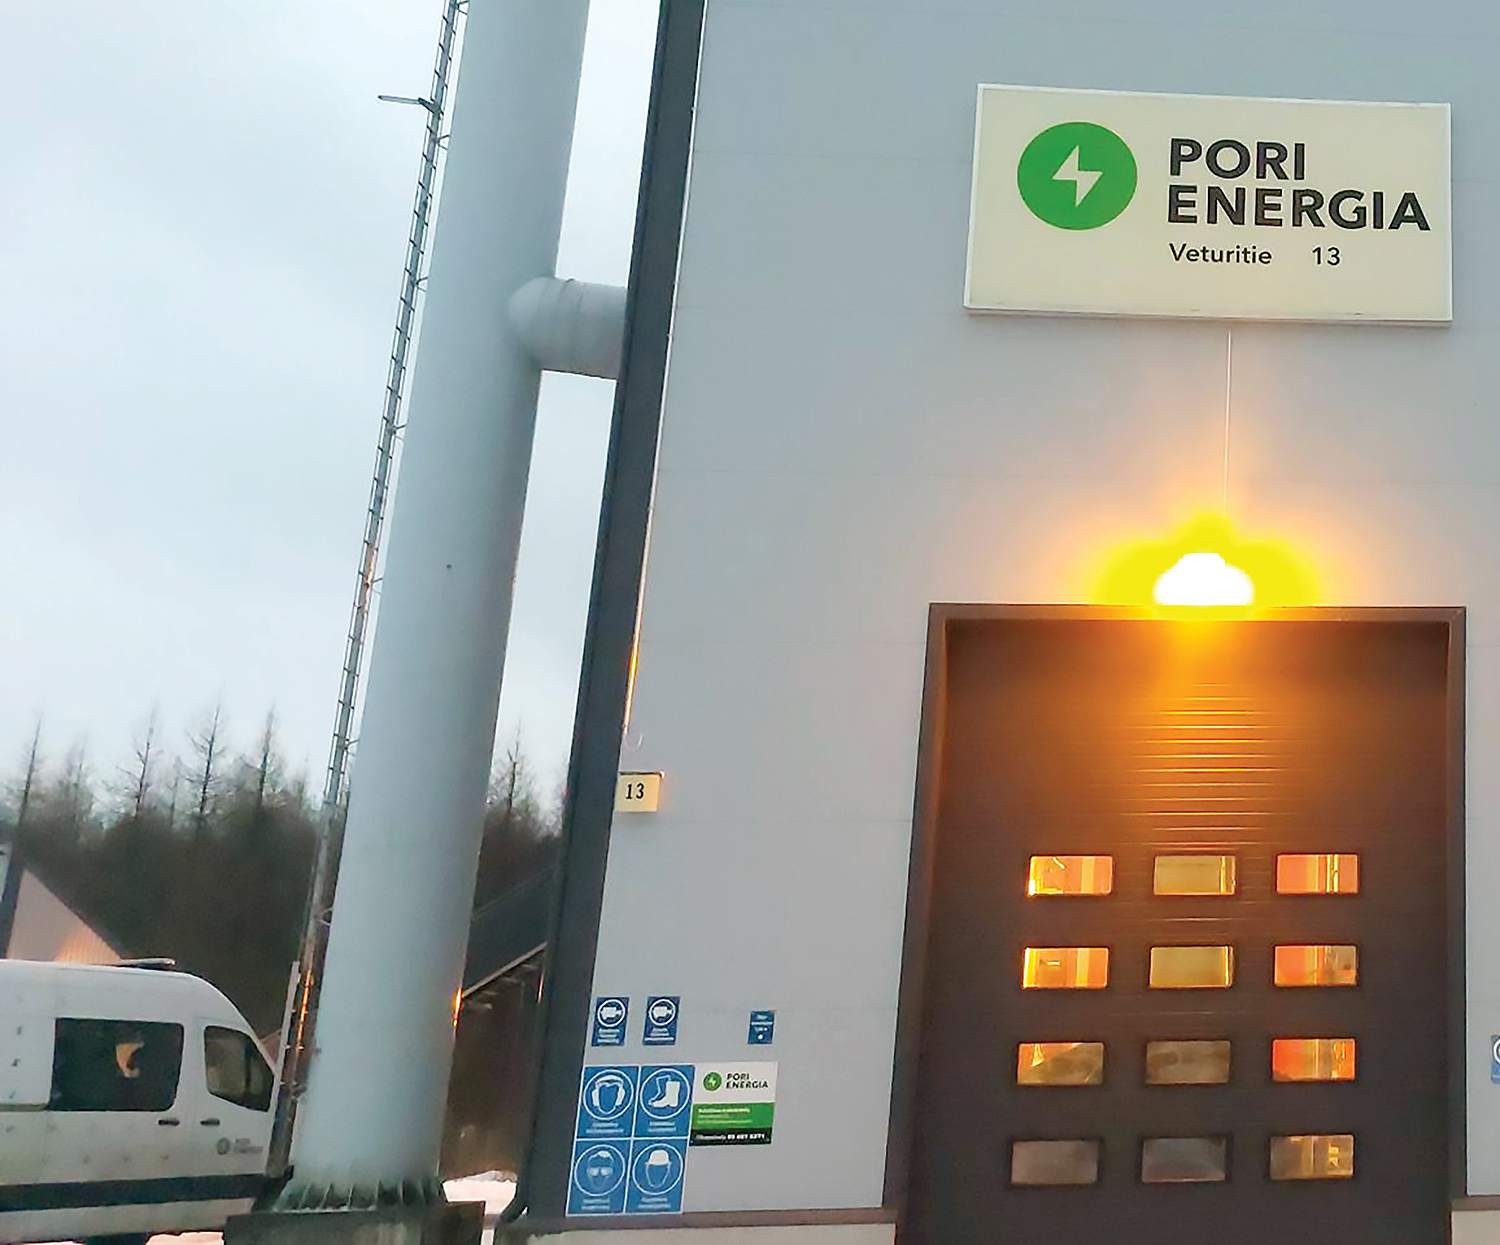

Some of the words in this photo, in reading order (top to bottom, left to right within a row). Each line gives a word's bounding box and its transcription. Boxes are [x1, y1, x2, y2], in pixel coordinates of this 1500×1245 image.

[1168, 137, 1306, 182] PORI
[1167, 184, 1432, 232] ENERGIA
[1168, 243, 1273, 266] Veturitie
[1311, 246, 1342, 267] 13
[625, 782, 645, 800] 13
[725, 1081, 769, 1089] ENERGIA
[726, 1072, 750, 1081] PORI
